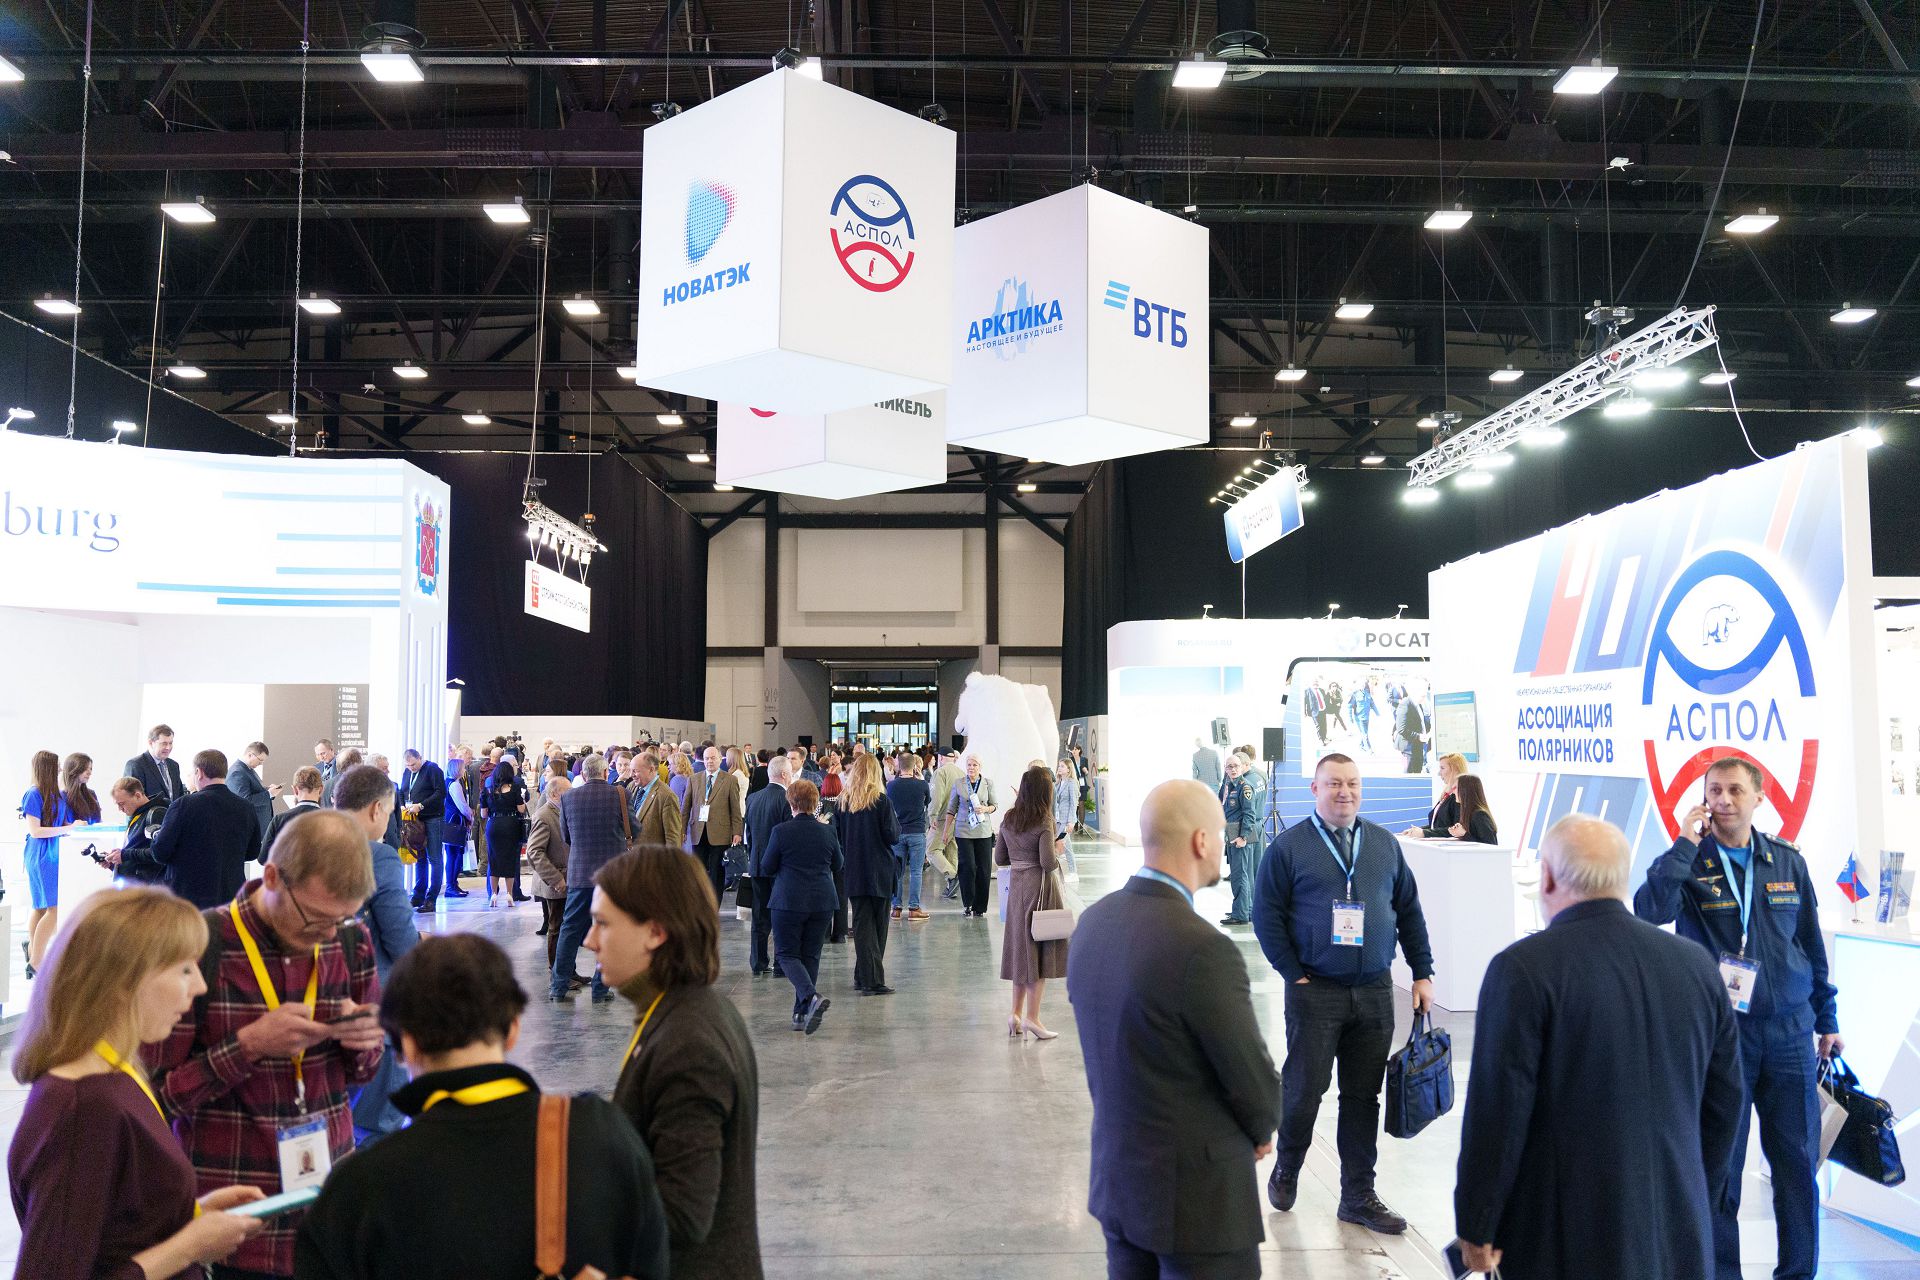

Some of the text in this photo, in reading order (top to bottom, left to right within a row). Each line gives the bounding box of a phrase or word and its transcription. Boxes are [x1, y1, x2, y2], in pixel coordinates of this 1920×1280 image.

[844, 219, 903, 250] АСПОЛ
[663, 262, 751, 307] НОВАТЭК
[966, 335, 1015, 353] НАСТОЯЩЕЕ
[1024, 323, 1064, 340] БУДУЩЕЕ
[967, 299, 1063, 344] АРКТИКА
[1134, 297, 1188, 348] ВТБ
[4, 490, 121, 553] burg
[1517, 703, 1613, 733] АССОЦИАЦИЯ
[1666, 698, 1787, 741] АСПОЛ
[1518, 738, 1614, 764] ПОЛЯРНИКОВ
